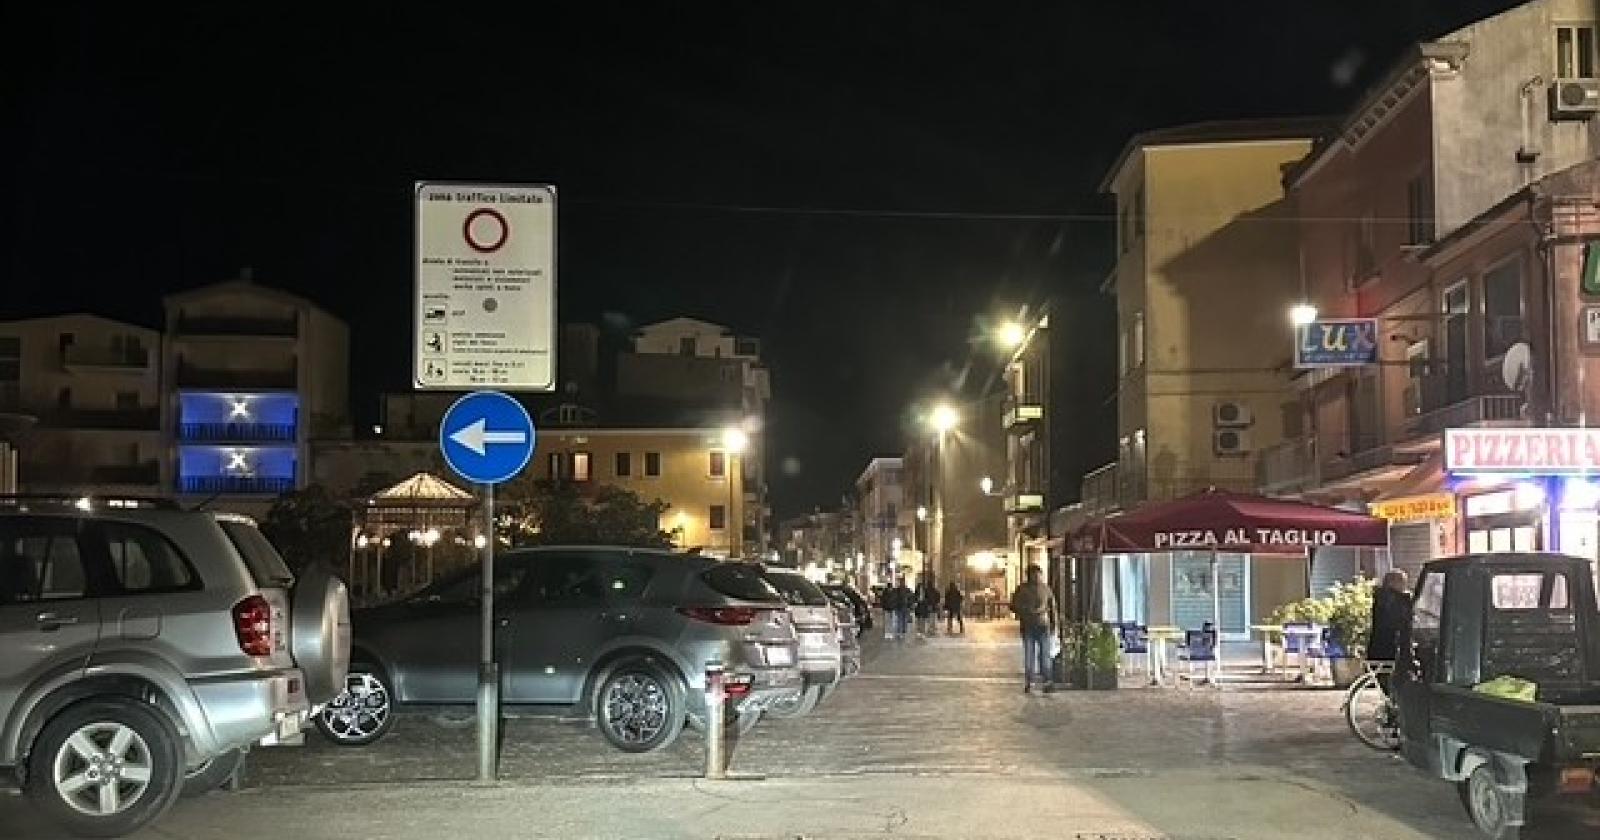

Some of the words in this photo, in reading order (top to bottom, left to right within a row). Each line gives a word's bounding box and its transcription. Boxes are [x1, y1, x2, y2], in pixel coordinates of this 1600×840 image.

[1154, 529, 1218, 548] PIZZA
[1224, 527, 1251, 544] AL
[1256, 528, 1337, 545] TAGLIO
